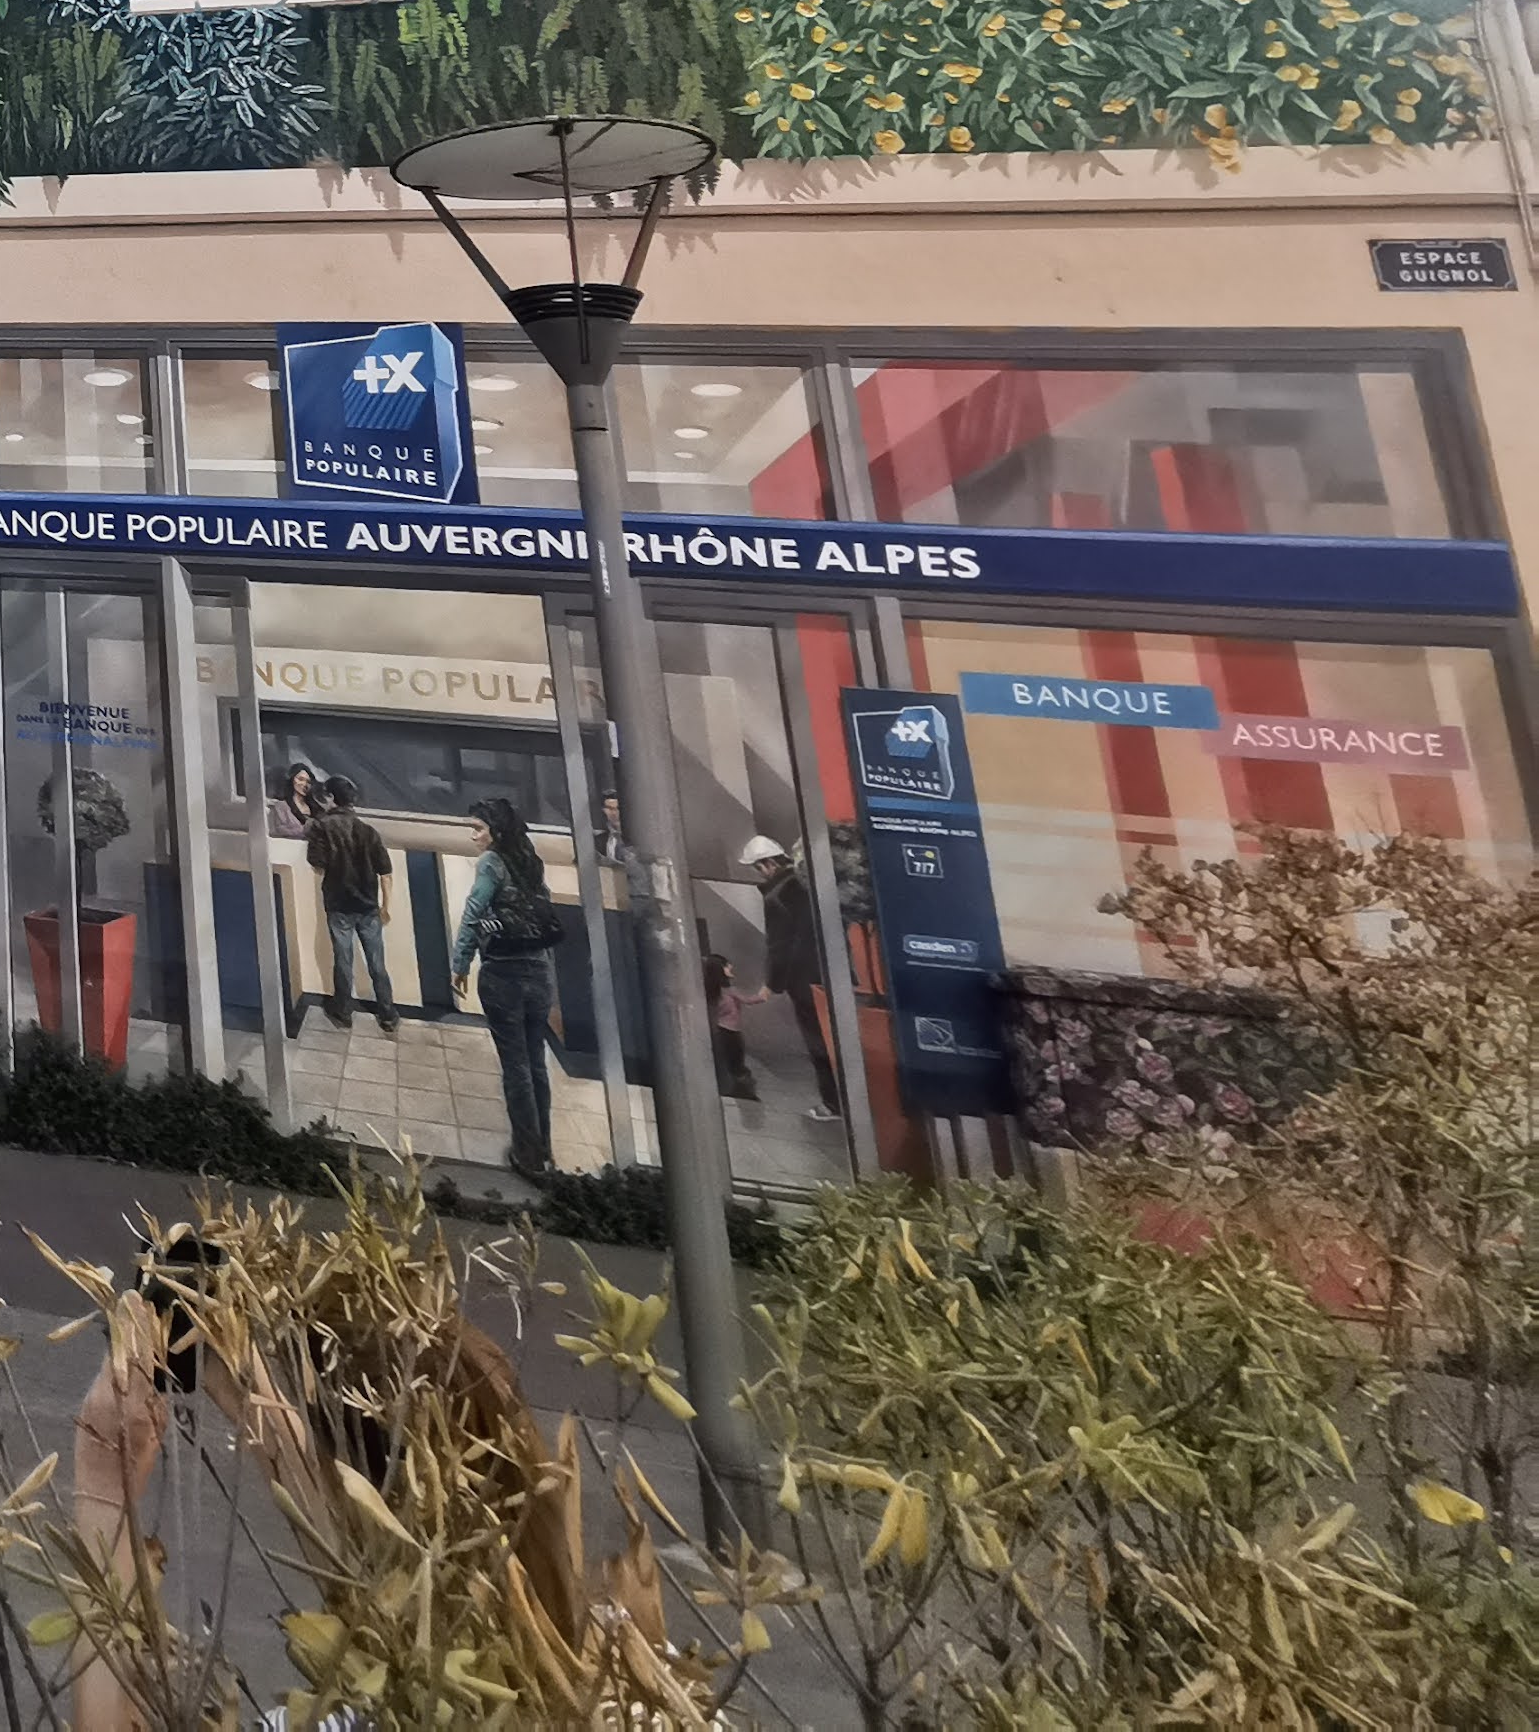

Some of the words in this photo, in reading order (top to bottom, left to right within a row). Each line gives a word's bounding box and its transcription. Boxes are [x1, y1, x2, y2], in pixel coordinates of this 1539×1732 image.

[1399, 251, 1482, 265] ESPACE
[1399, 269, 1494, 283] GUIGNOL
[304, 440, 435, 464] BANQUE
[306, 458, 439, 487] POPULAIRE
[126, 513, 329, 550] POPULAIRE
[345, 522, 590, 561] AUVERGN
[622, 526, 802, 571] RHÔNE
[815, 540, 982, 580] ALPES
[196, 657, 364, 694] BNQUE
[39, 701, 130, 719] BIENVENUE
[1012, 683, 1172, 716] BANQUE
[1232, 723, 1445, 757] ASSURANCE
[868, 773, 943, 793] POPULAIRE
